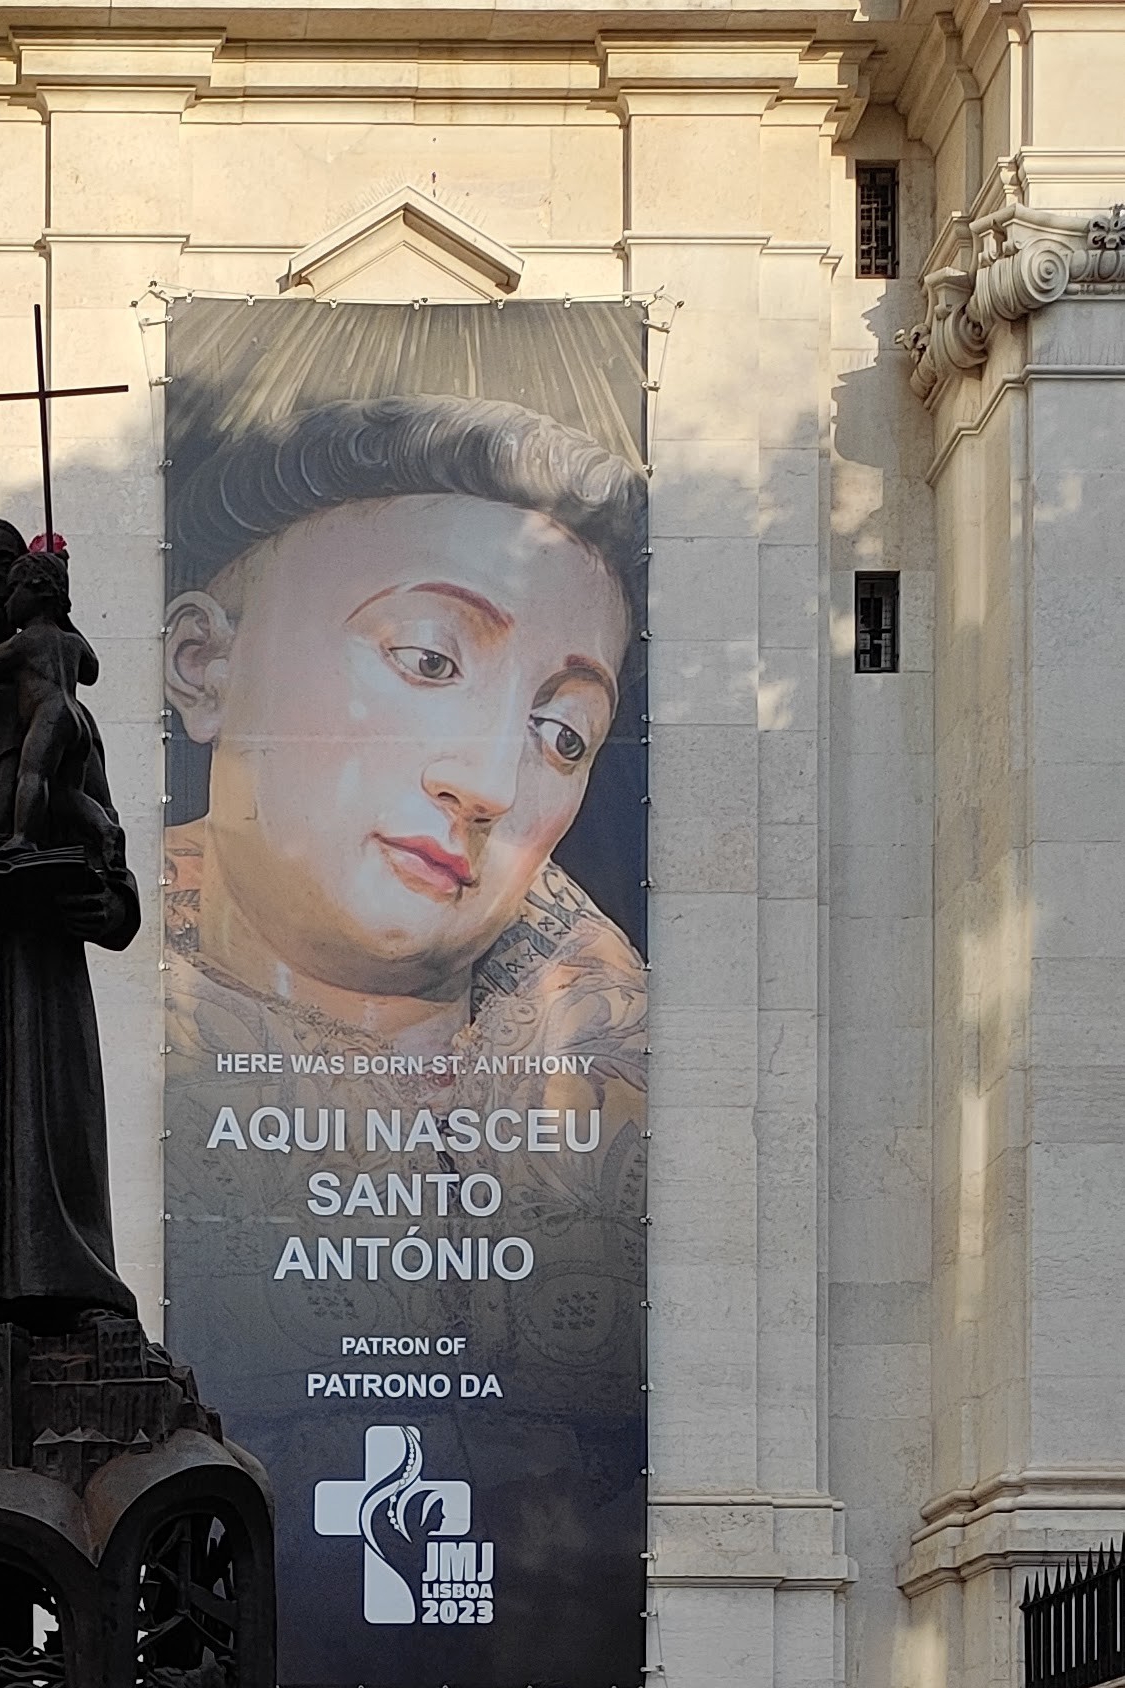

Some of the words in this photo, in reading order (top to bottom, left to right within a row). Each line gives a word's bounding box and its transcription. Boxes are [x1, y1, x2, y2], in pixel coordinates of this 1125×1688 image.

[216, 1053, 283, 1074] HERE
[290, 1054, 345, 1075] WAS
[353, 1055, 423, 1075] BORN
[431, 1055, 467, 1075] ST.
[473, 1055, 595, 1075] ANTHONY
[206, 1106, 346, 1154] AQUI
[366, 1108, 601, 1153] NASCEU
[307, 1172, 502, 1217] SANTO
[273, 1226, 535, 1281] ANTÓNIO
[341, 1336, 429, 1356] PATRON
[435, 1336, 467, 1355] OF
[306, 1373, 451, 1398] PATRONO
[460, 1374, 504, 1398] DA
[421, 1541, 494, 1582] JMJ
[421, 1583, 494, 1599] LISBOA
[421, 1600, 494, 1624] 2023
